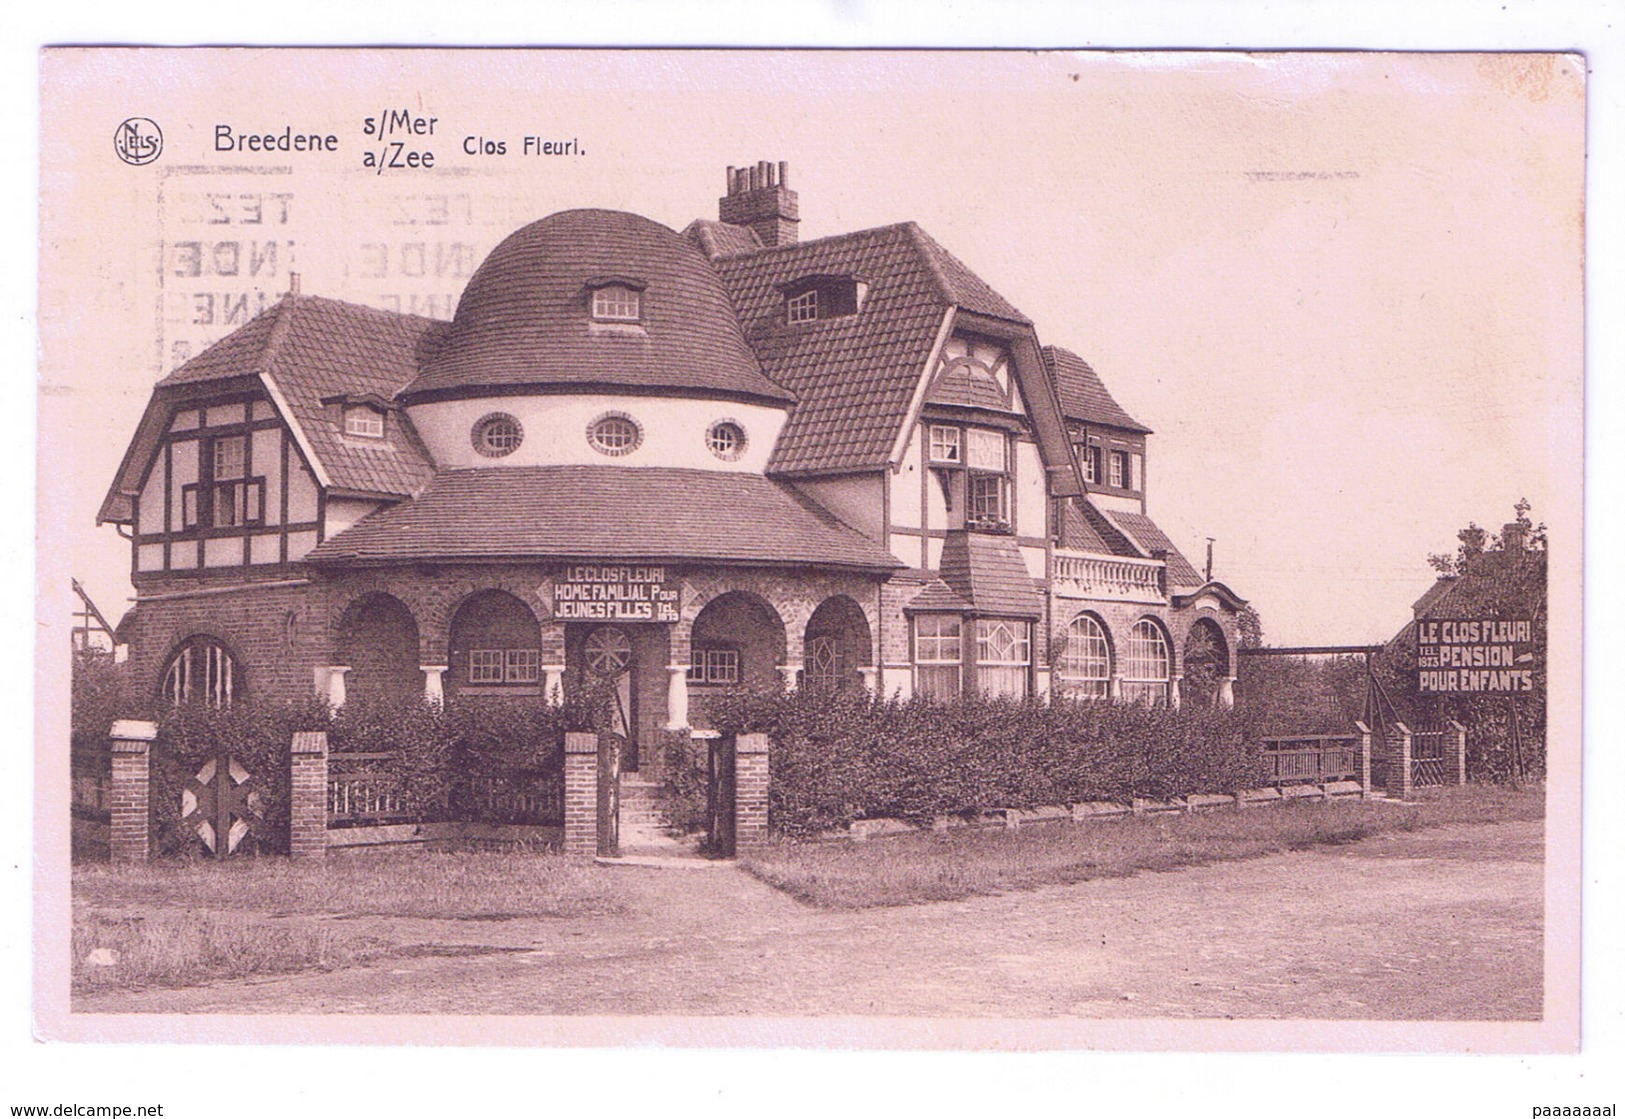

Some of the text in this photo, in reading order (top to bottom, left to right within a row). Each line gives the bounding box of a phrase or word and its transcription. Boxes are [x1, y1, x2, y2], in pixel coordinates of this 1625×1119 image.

[363, 109, 438, 141] s/Mer
[215, 125, 338, 151] Breedene
[463, 136, 586, 155] Clos Fleuri.
[363, 142, 435, 175] a/Zee
[555, 584, 591, 600] HOME
[592, 584, 648, 600] FAMILIAL
[555, 602, 652, 618] JEUNES FILLES
[1420, 621, 1530, 643] LE CLOS FLEURI
[1440, 645, 1514, 667] PENSION
[1420, 669, 1533, 691] POUR ENFANTS
